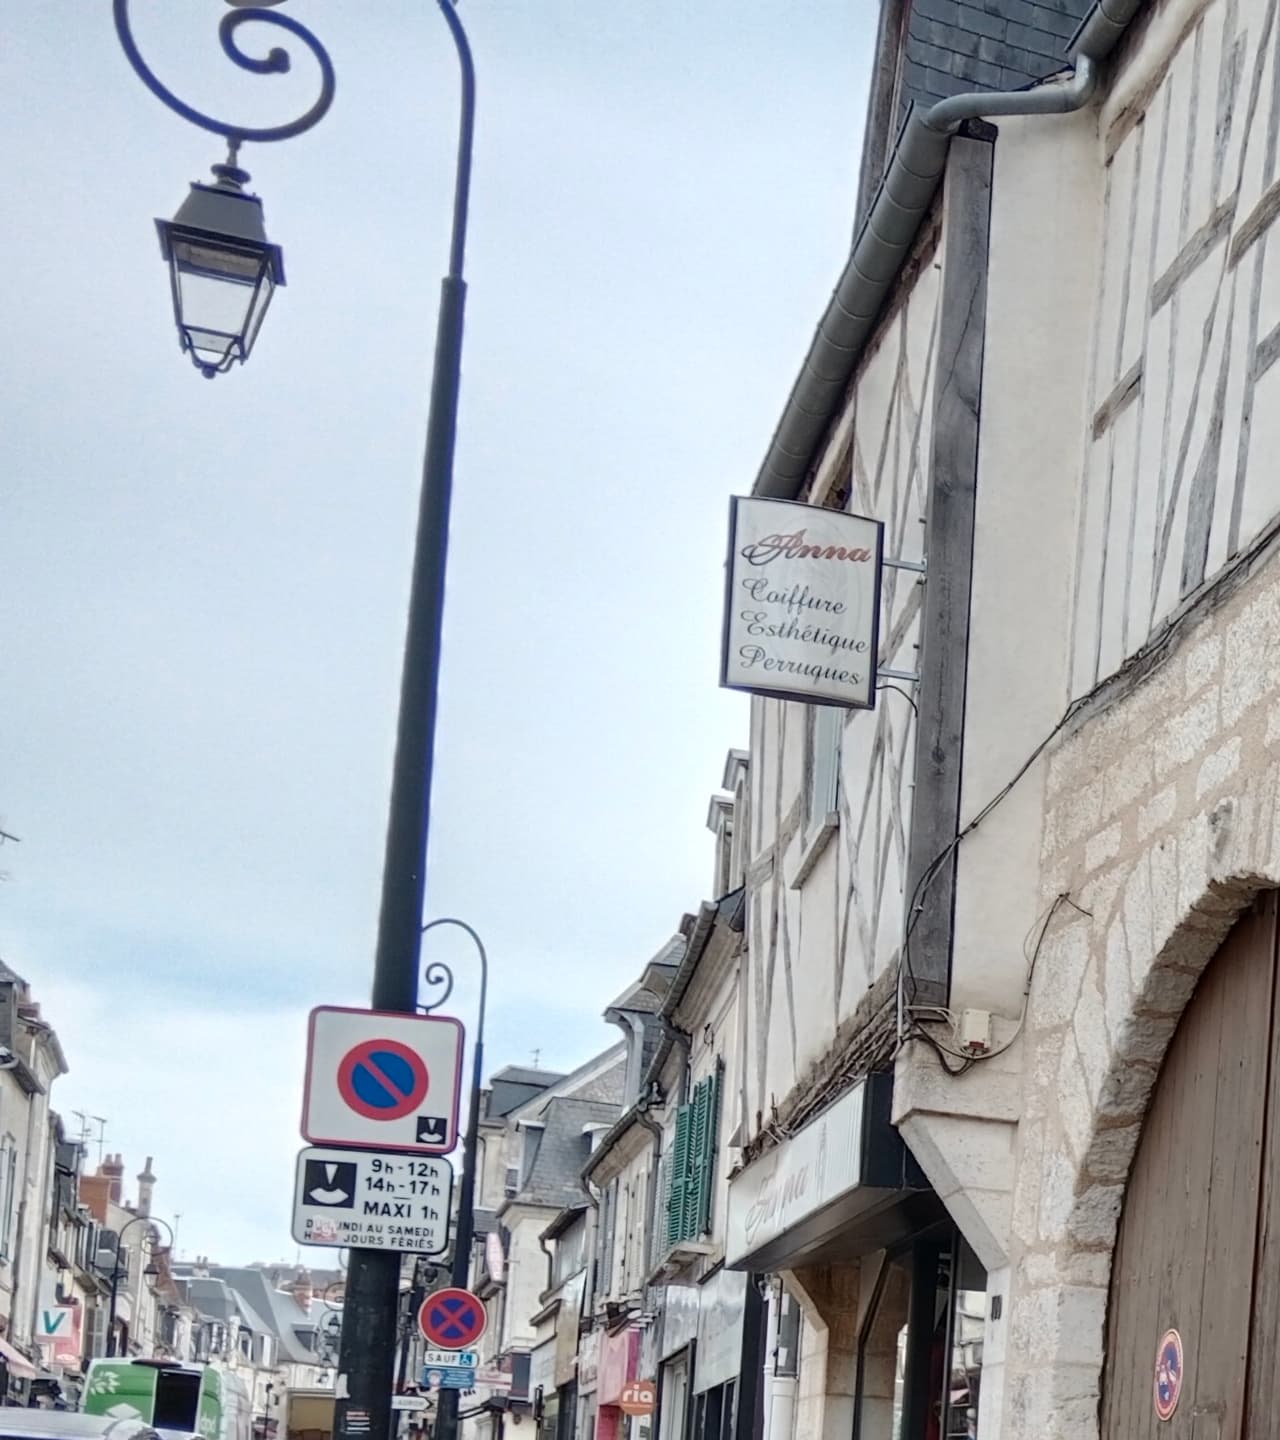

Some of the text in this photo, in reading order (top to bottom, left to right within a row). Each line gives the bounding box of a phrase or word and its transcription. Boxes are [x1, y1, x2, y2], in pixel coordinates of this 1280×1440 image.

[741, 528, 872, 566] Anna
[742, 577, 847, 615] Coiffure
[740, 610, 870, 655] Esthétique
[739, 644, 865, 685] Perruques
[363, 1201, 439, 1221] MAXI 1h
[367, 1224, 383, 1234] AU
[388, 1225, 434, 1237] SAMEDI
[343, 1235, 384, 1245] JOURS
[391, 1236, 434, 1249] FÉRIÉS
[428, 1352, 457, 1364] SAUF
[623, 1384, 654, 1403] ria
